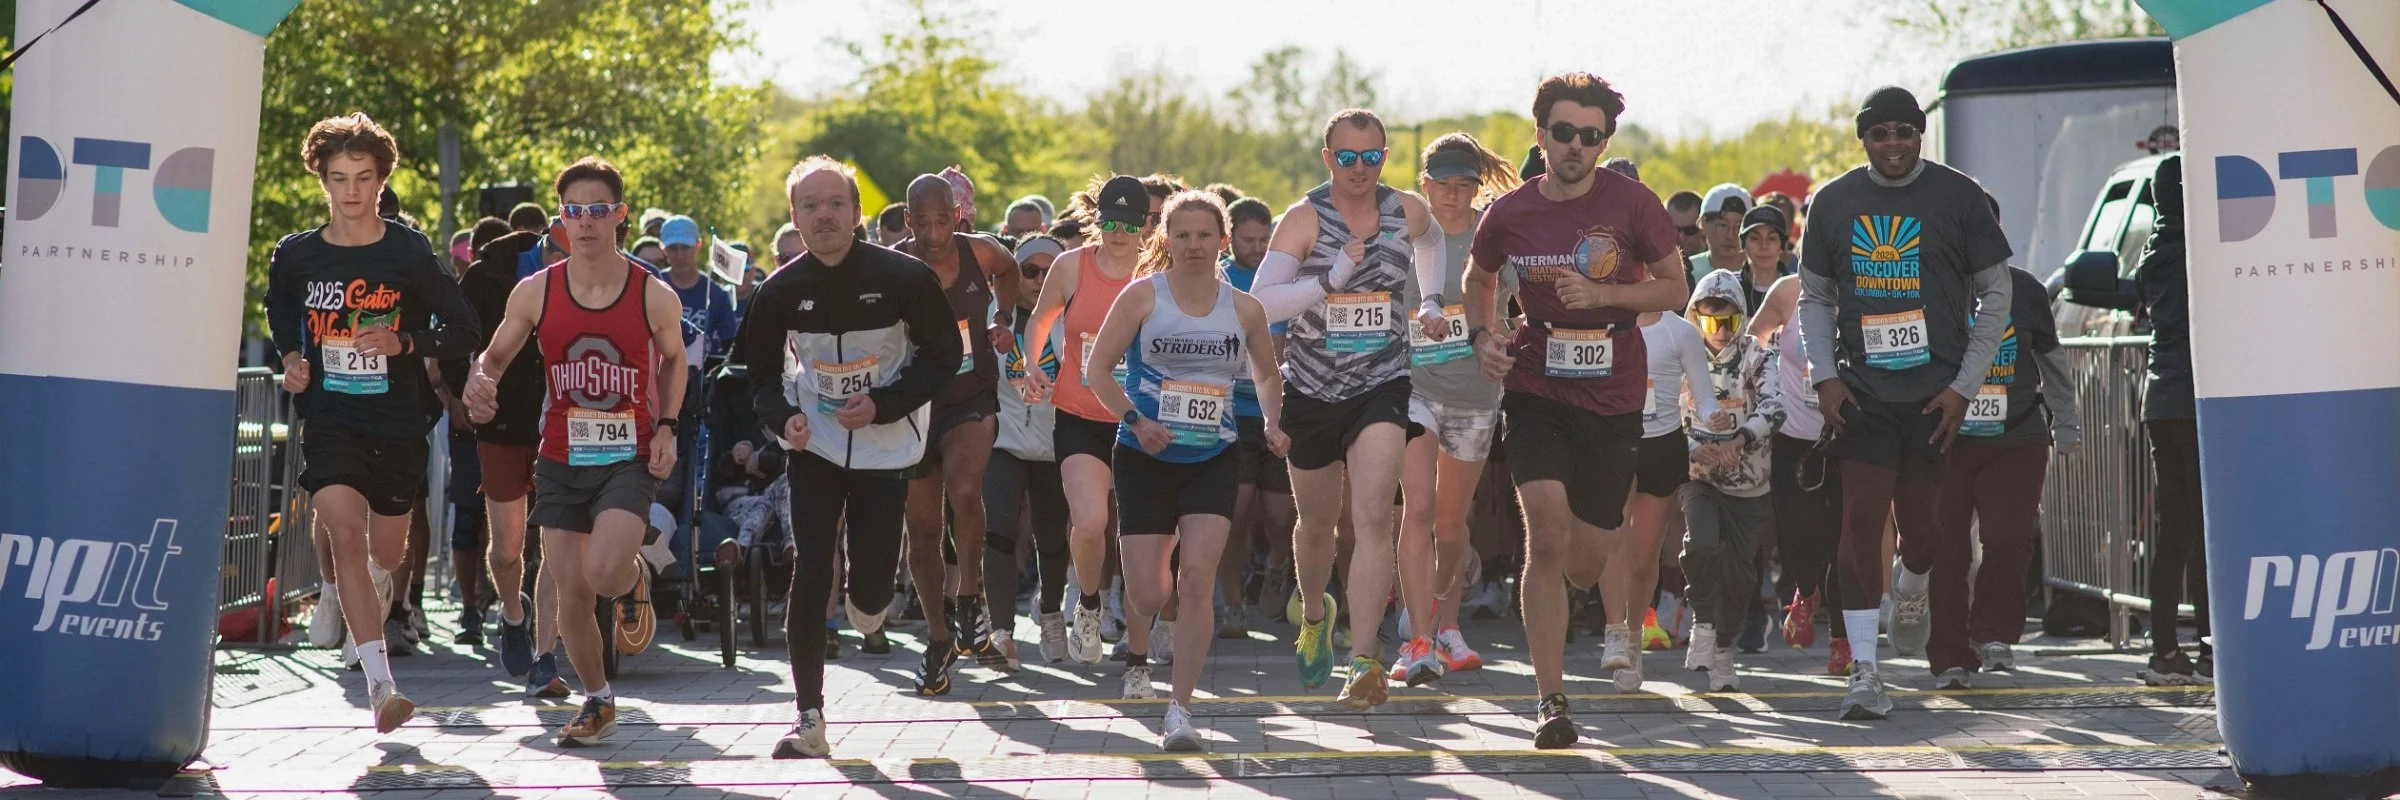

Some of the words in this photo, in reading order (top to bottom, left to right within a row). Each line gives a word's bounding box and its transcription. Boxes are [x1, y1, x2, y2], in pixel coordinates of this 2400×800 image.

[15, 135, 216, 234] DTC
[21, 245, 195, 268] PARTNERSHIP
[1508, 253, 1588, 266] WATERMAN'S
[1875, 251, 1895, 260] 2025
[1852, 260, 1920, 278] DISCOVER
[1855, 275, 1920, 290] DOWNTOWN
[305, 280, 345, 310] 2025
[345, 277, 401, 310] Gator
[1854, 288, 1888, 298] COLUMBIA
[1891, 289, 1902, 299] 5K
[1906, 289, 1920, 299] 10K
[1354, 306, 1384, 327] 215
[1888, 325, 1920, 347] 326
[1149, 338, 1226, 356] STRIDERS
[1573, 344, 1605, 365] 302
[347, 351, 379, 370] 213
[551, 361, 586, 400] OHIO
[588, 355, 640, 404] STATE
[841, 371, 872, 395] 254
[1187, 398, 1217, 420] 632
[1971, 398, 2000, 417] 325
[595, 423, 628, 441] 794
[58, 612, 165, 641] events
